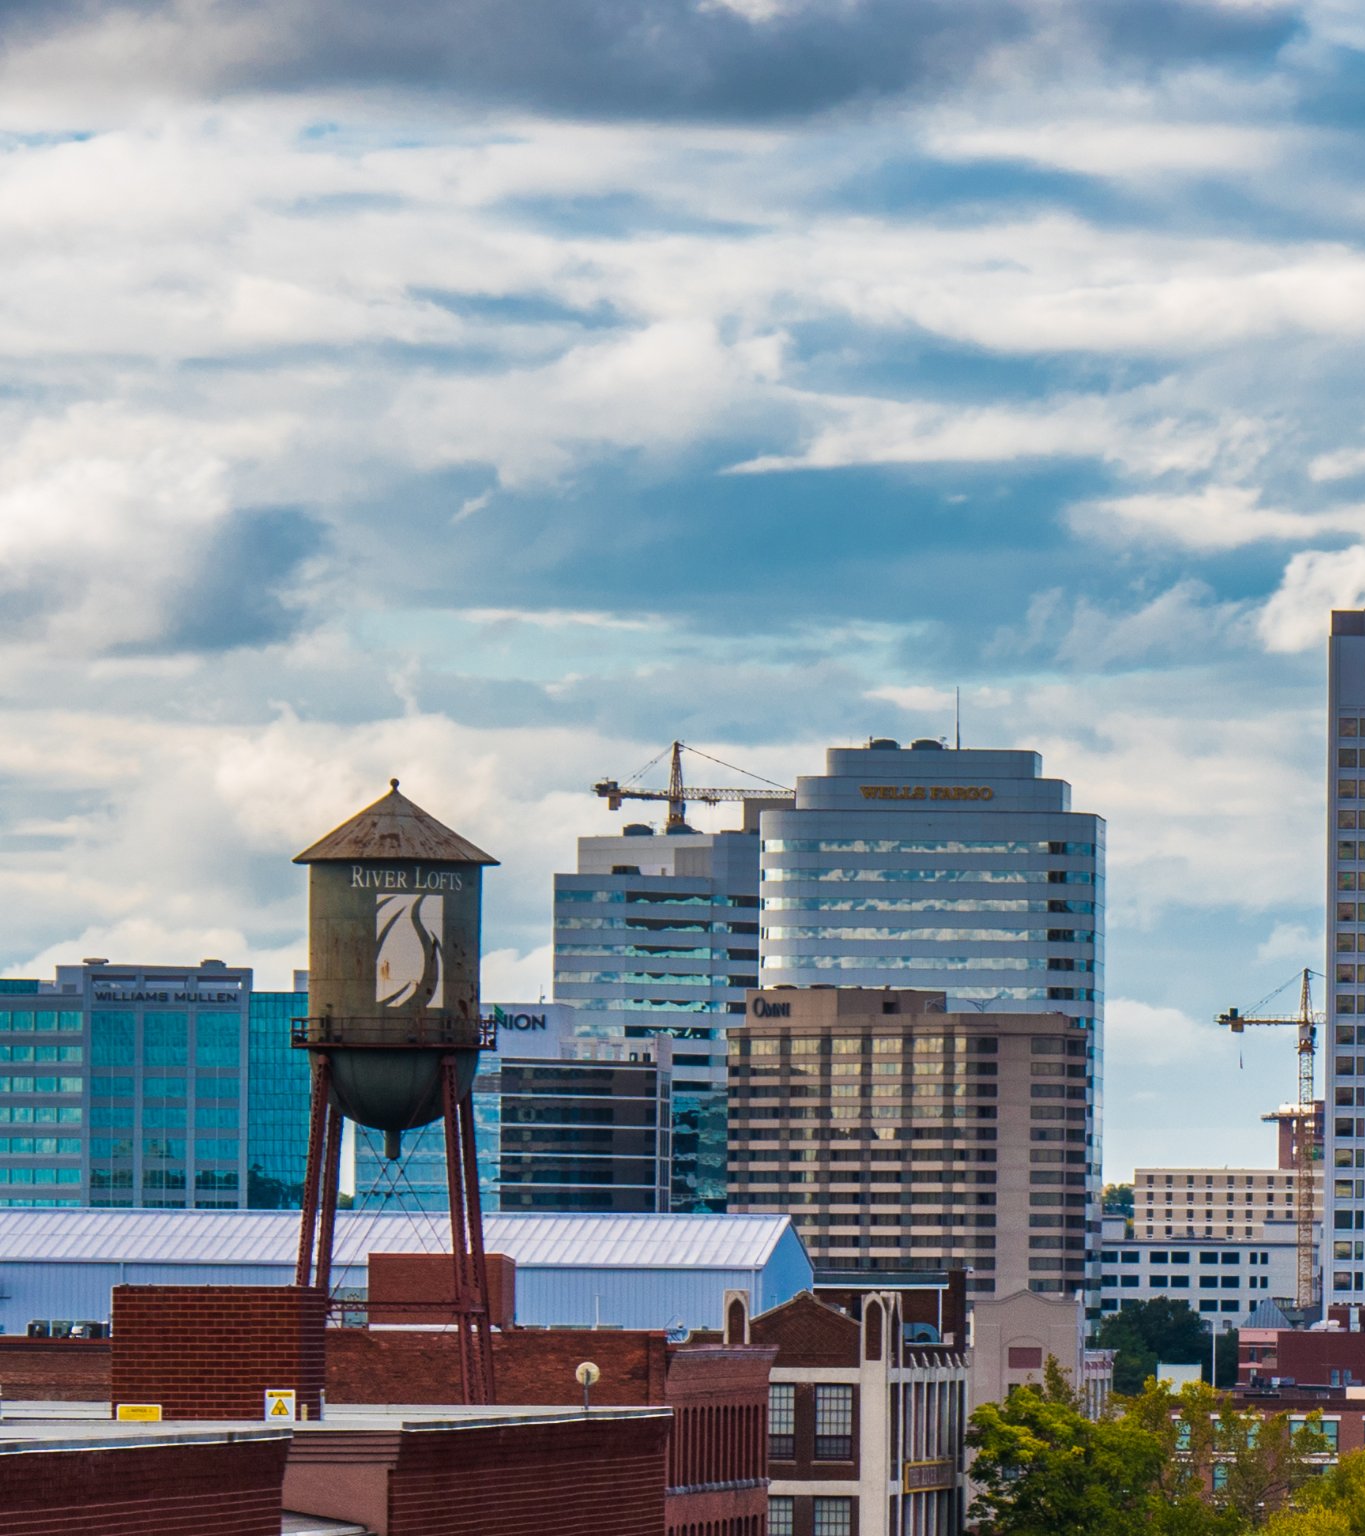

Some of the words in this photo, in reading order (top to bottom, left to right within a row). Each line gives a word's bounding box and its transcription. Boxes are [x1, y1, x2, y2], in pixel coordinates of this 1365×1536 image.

[859, 785, 926, 800] WELLS
[929, 785, 993, 801] FARGO
[95, 991, 169, 1002] WILLIAMS
[174, 992, 238, 1003] MULLEN
